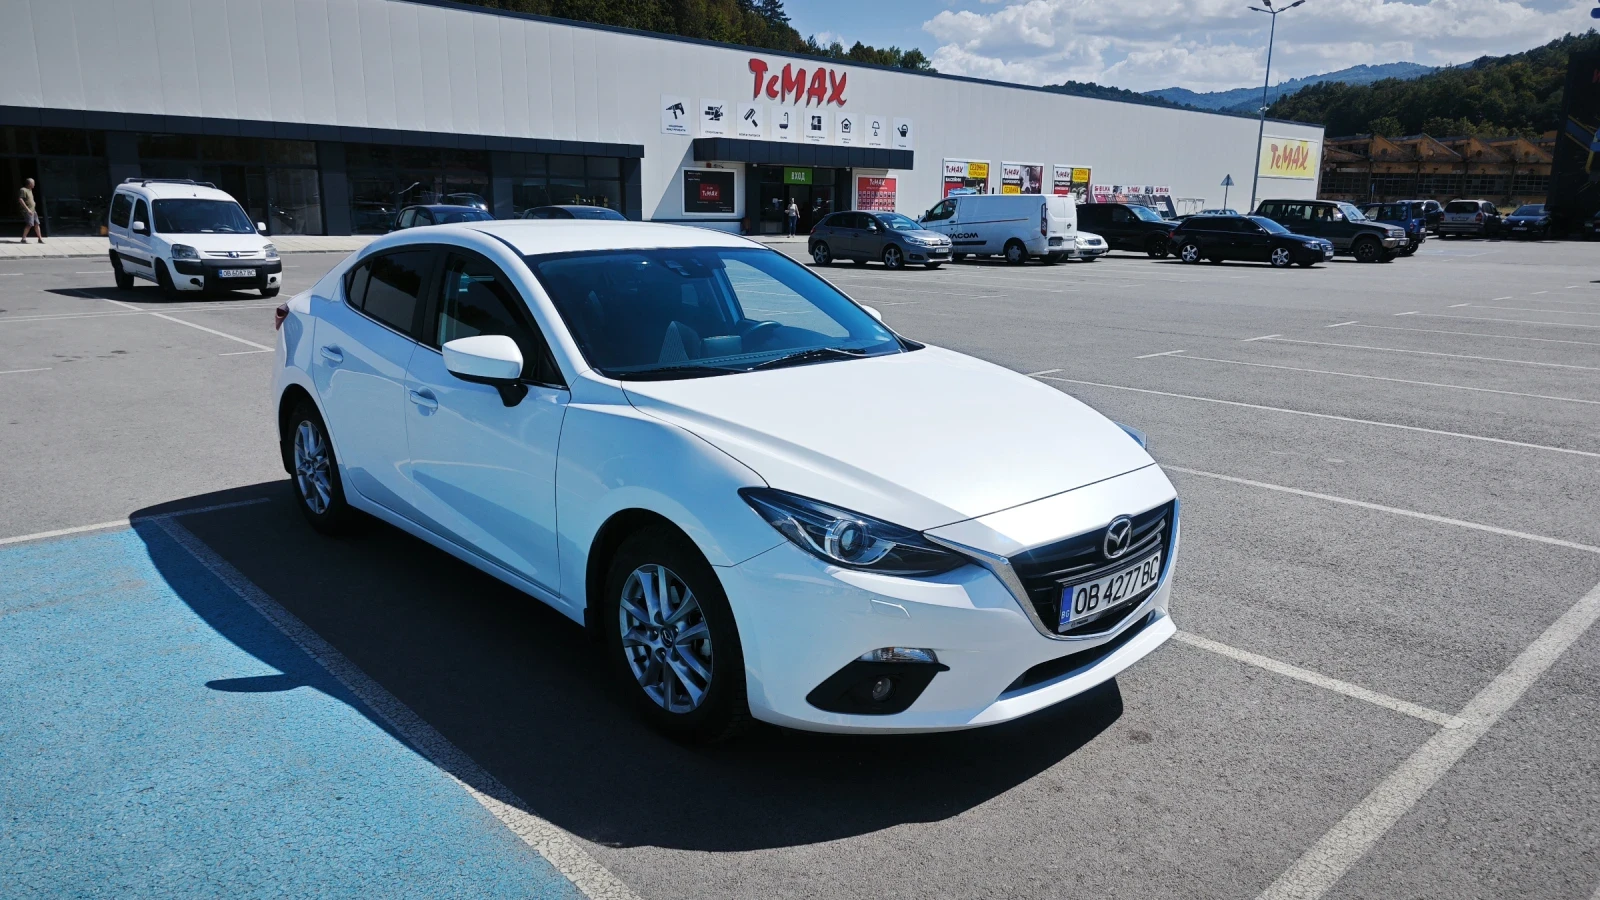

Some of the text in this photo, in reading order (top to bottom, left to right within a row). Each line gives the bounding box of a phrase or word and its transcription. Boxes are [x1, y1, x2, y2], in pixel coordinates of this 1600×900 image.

[748, 58, 847, 107] TeMAX
[1270, 143, 1309, 170] TeMAX
[791, 171, 806, 181] ВХОД
[1074, 555, 1159, 614] OB 4277 BC
[1061, 609, 1070, 619] BG
